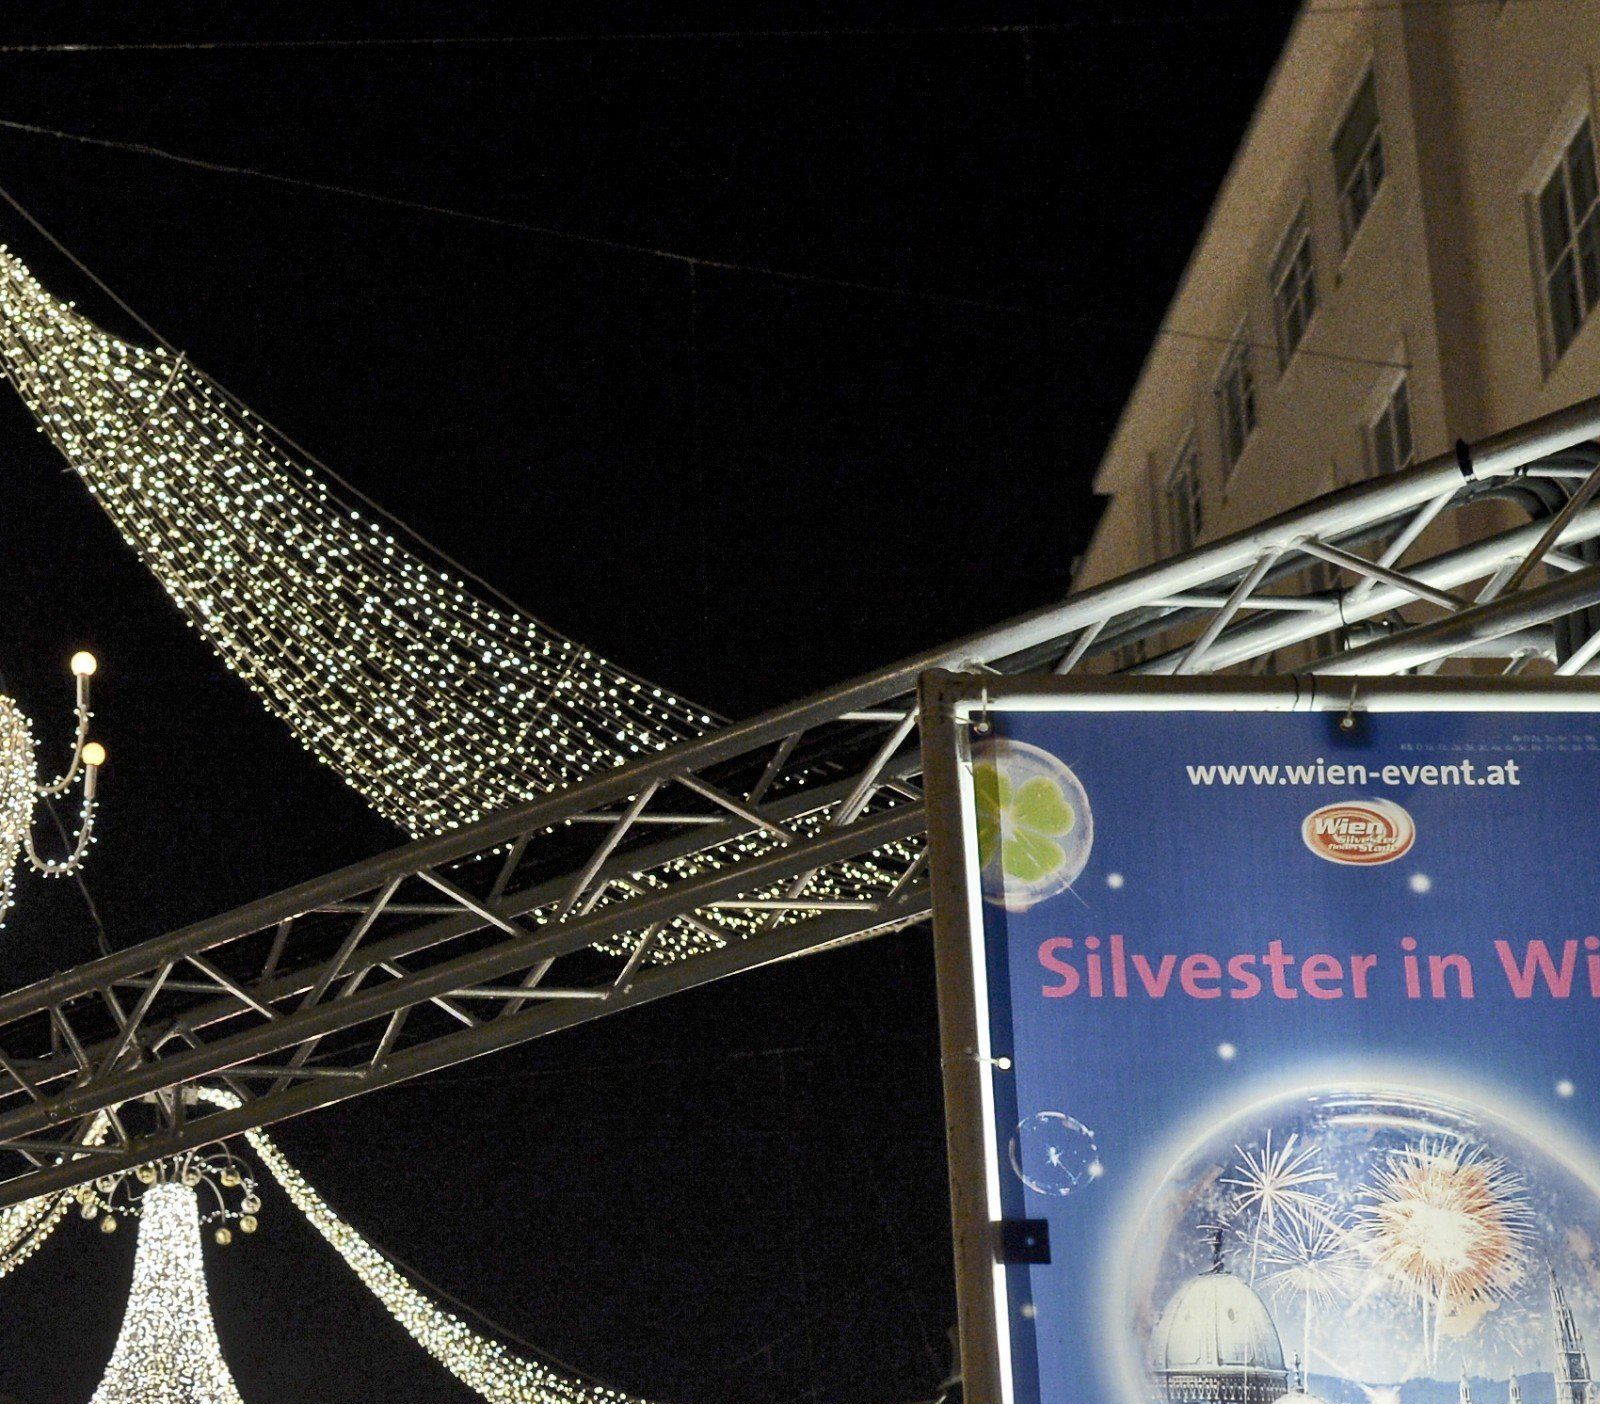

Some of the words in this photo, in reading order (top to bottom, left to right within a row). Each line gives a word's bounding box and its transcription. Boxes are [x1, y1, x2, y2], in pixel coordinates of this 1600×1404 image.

[1186, 757, 1521, 786] www.wien-event.at
[1314, 817, 1385, 835] Wien
[1038, 934, 1378, 999] Silvester
[1402, 936, 1475, 998] in
[1493, 935, 1600, 998] Wi
